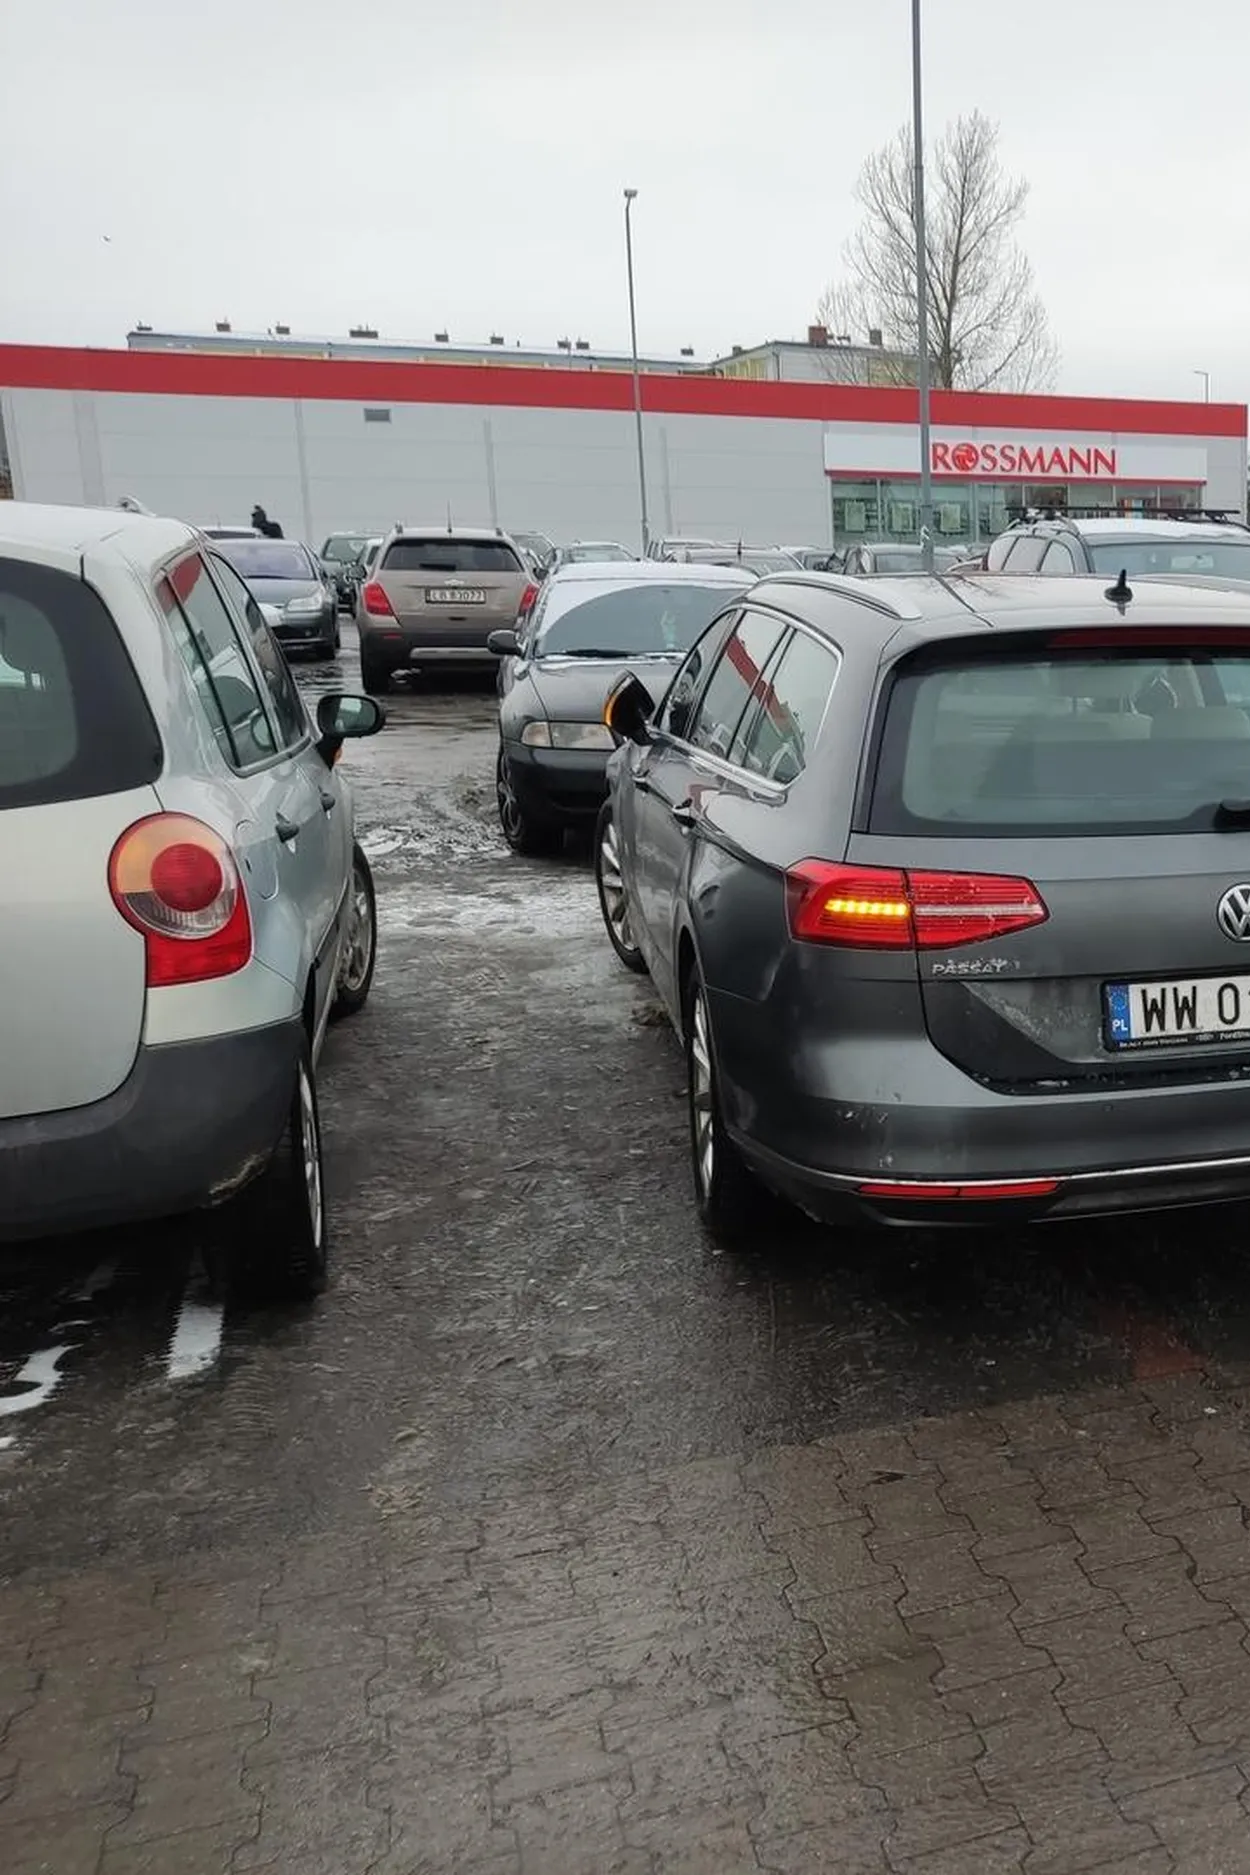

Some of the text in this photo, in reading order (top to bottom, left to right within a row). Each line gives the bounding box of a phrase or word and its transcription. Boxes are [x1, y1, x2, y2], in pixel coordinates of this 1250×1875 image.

[931, 442, 1116, 475] ROSSMANN
[1112, 1018, 1129, 1032] PL
[1141, 986, 1198, 1033] WW
